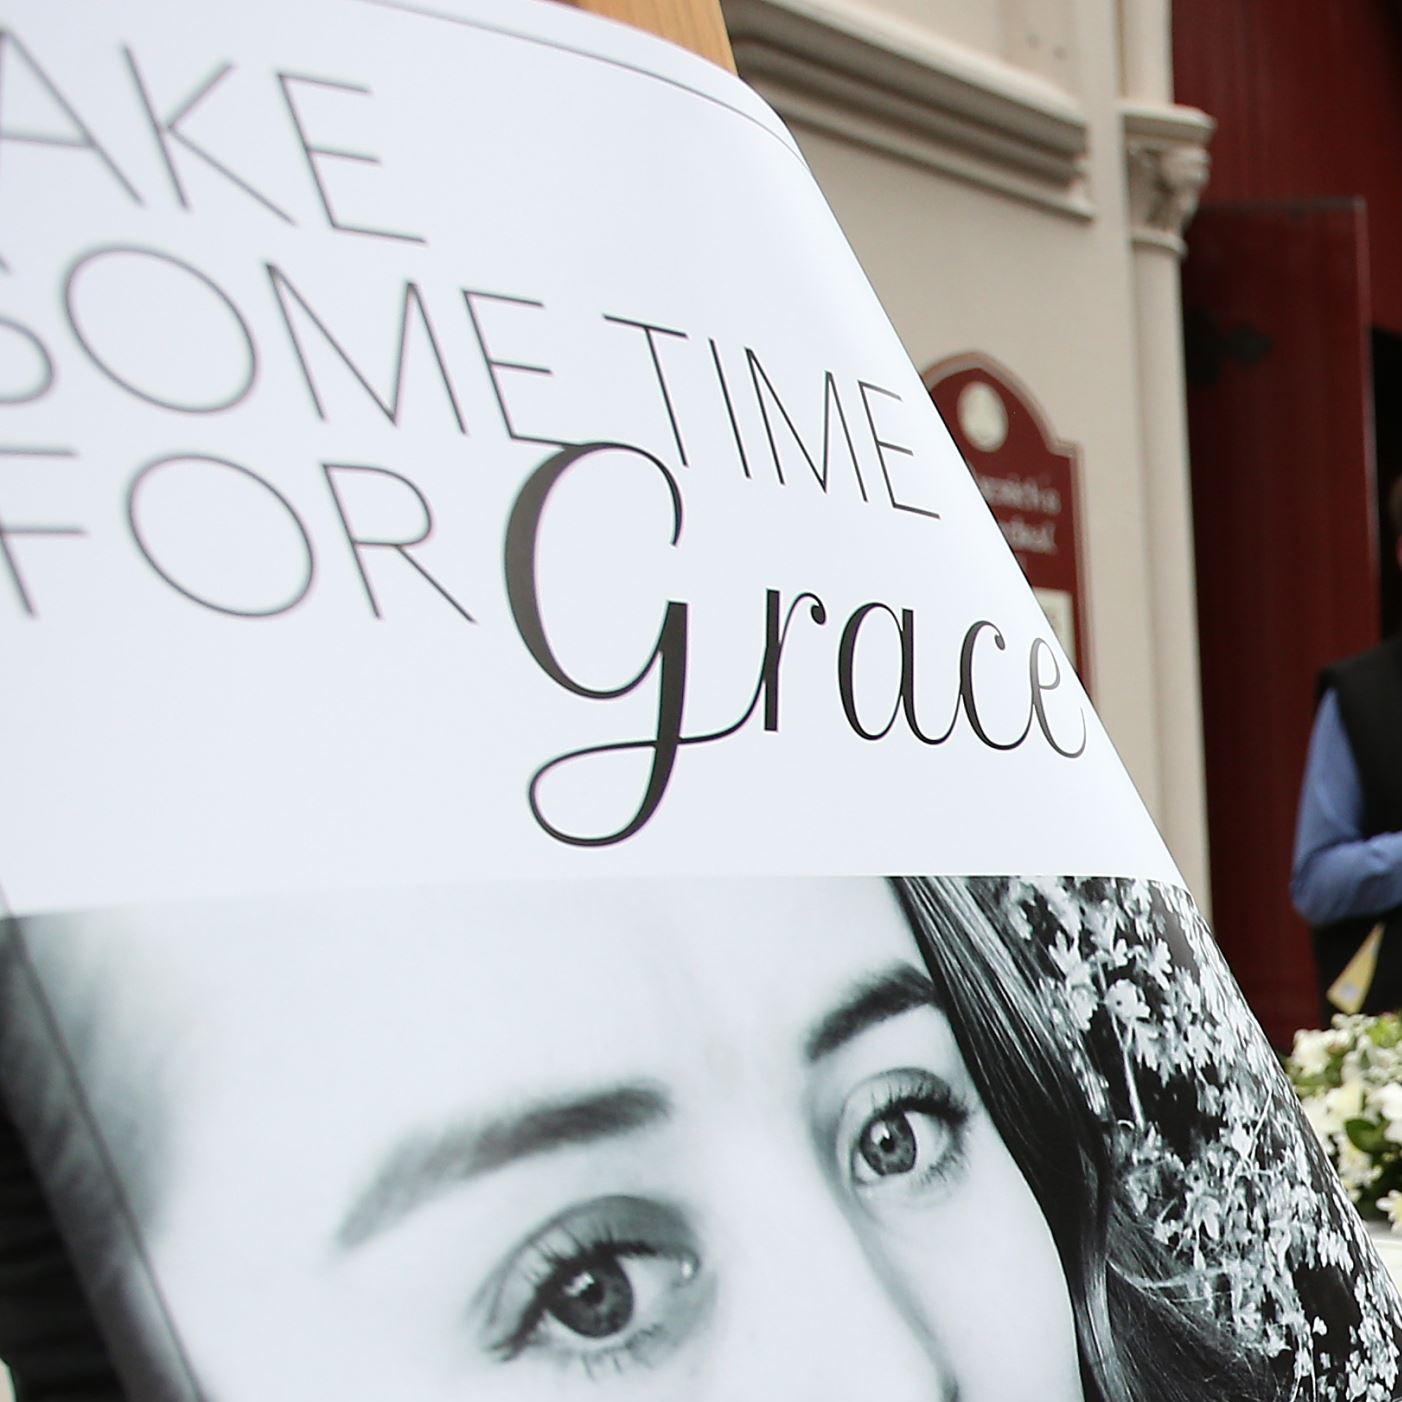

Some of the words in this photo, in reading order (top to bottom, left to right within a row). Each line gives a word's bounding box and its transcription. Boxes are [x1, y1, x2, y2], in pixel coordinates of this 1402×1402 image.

[602, 313, 942, 520] TIME
[0, 448, 476, 625] FOR
[504, 441, 1087, 848] Grace
